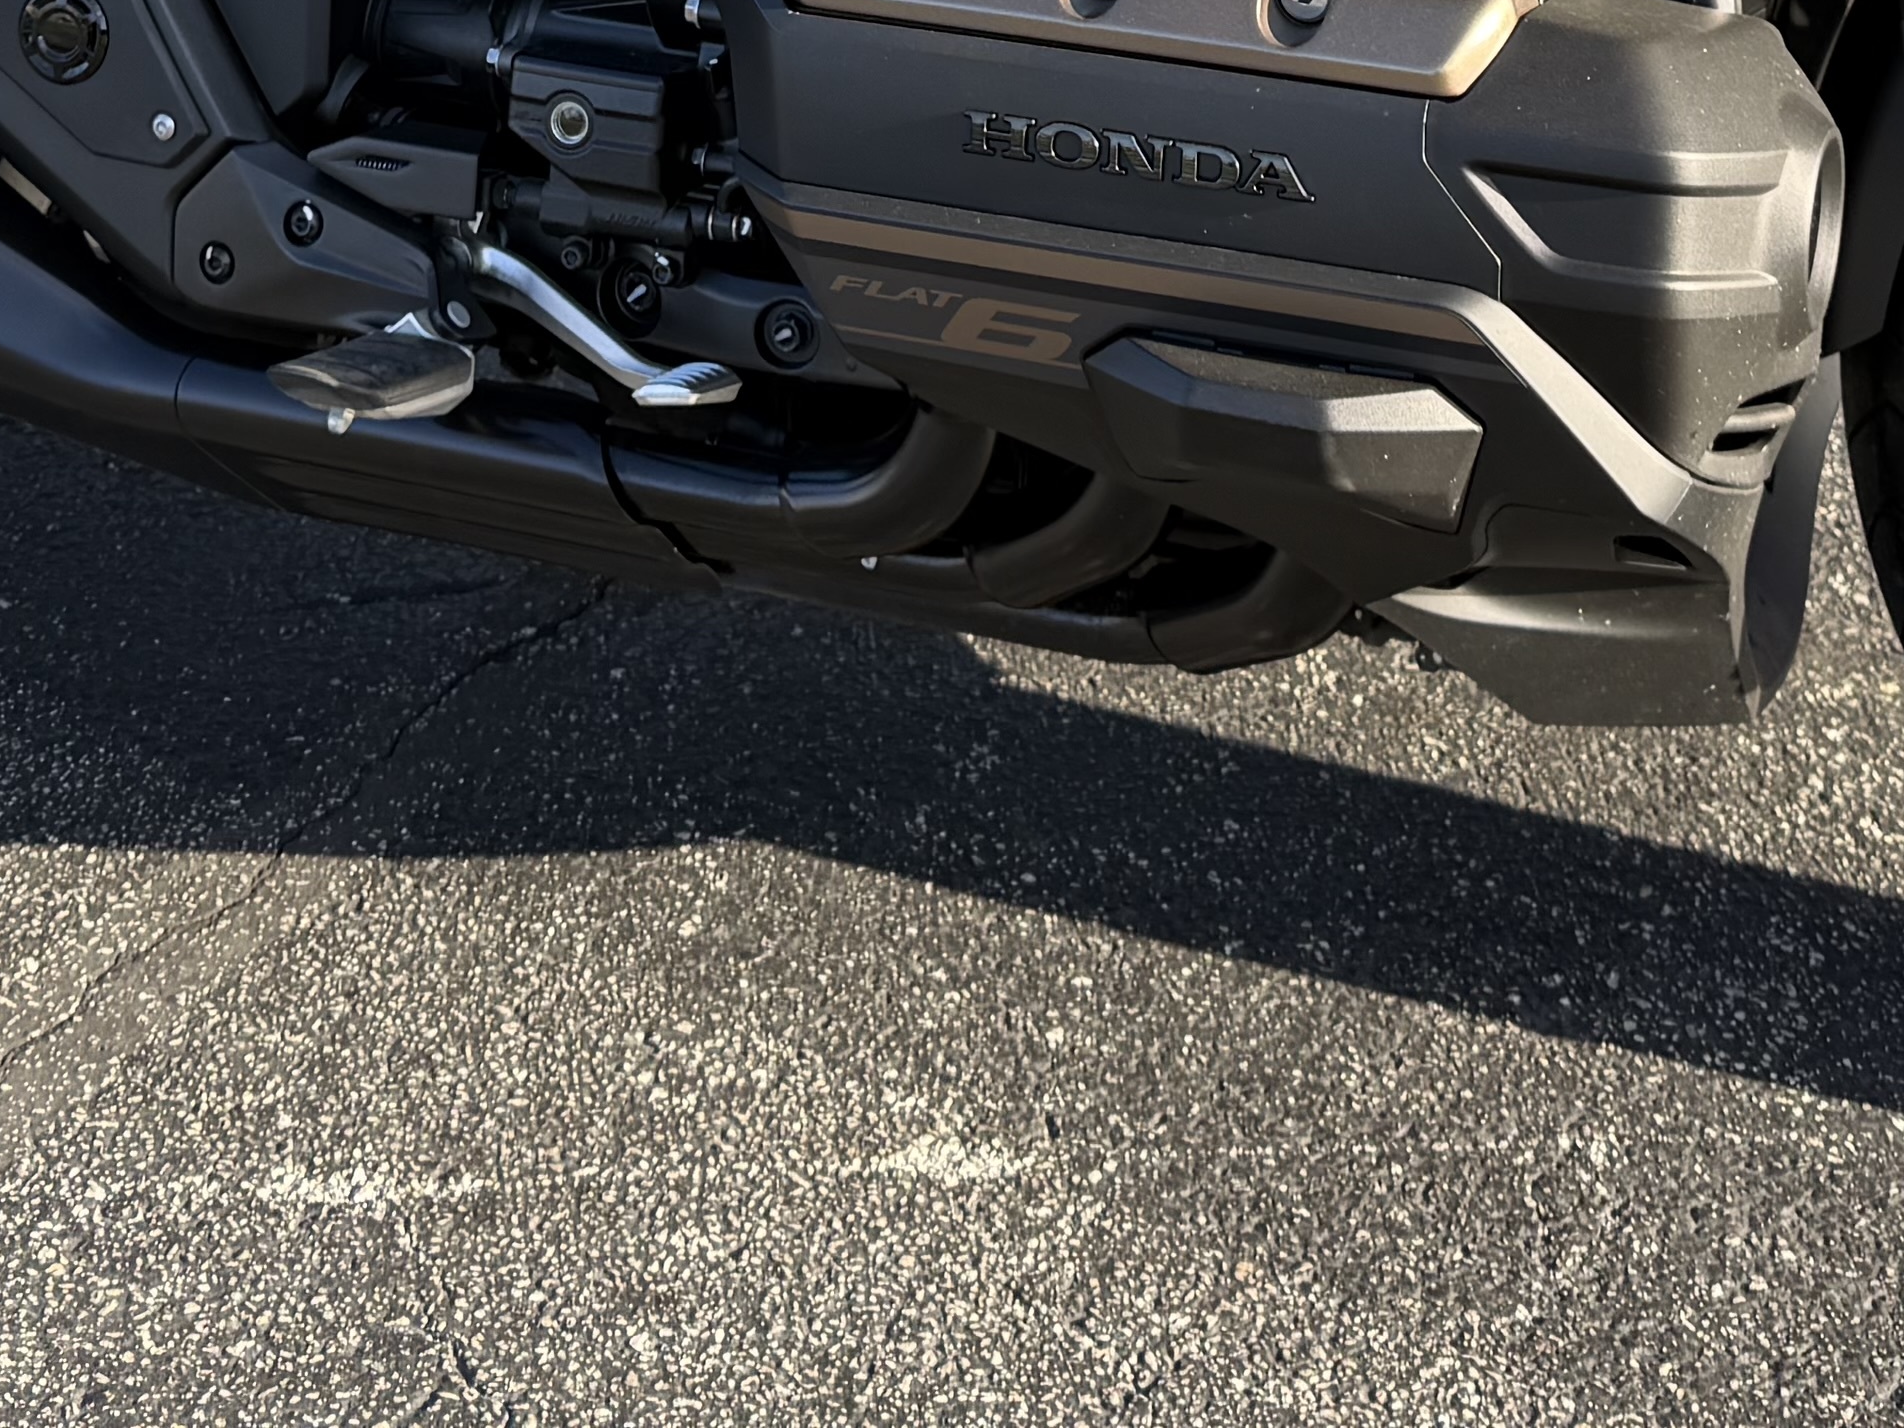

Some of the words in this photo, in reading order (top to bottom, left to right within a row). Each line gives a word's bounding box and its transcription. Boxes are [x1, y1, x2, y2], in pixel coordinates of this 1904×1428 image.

[962, 110, 1316, 204] HONDA
[829, 274, 963, 308] FLAT
[940, 297, 1082, 361] 6
